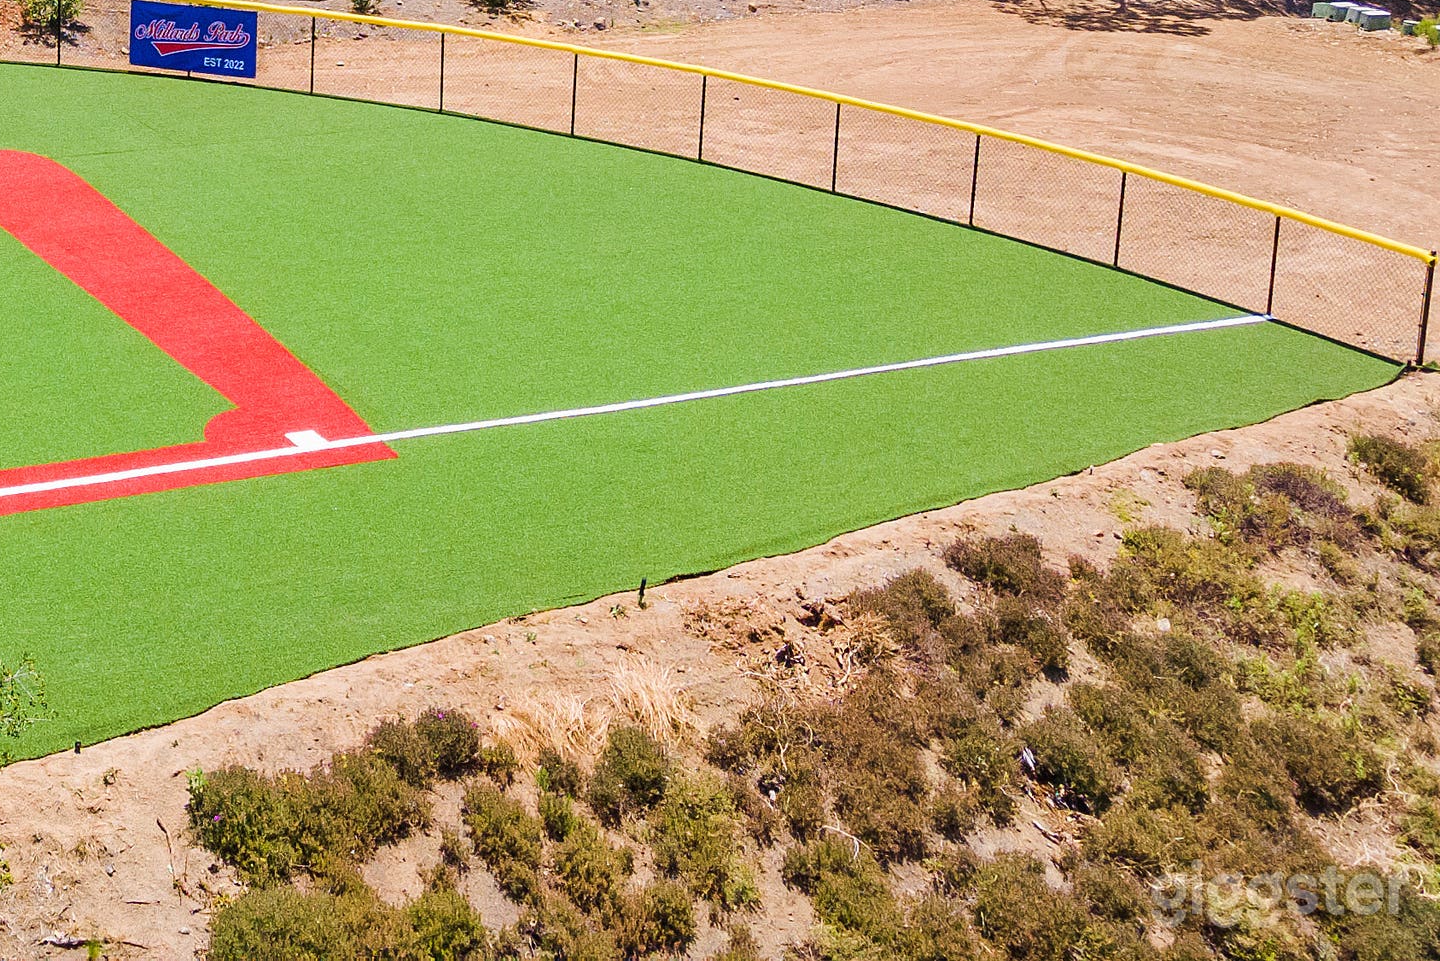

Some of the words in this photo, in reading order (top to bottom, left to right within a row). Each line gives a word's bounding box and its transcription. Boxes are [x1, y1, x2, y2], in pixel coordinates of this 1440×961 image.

[203, 21, 246, 42] Park
[204, 57, 222, 67] EST
[224, 59, 244, 70] 2022
